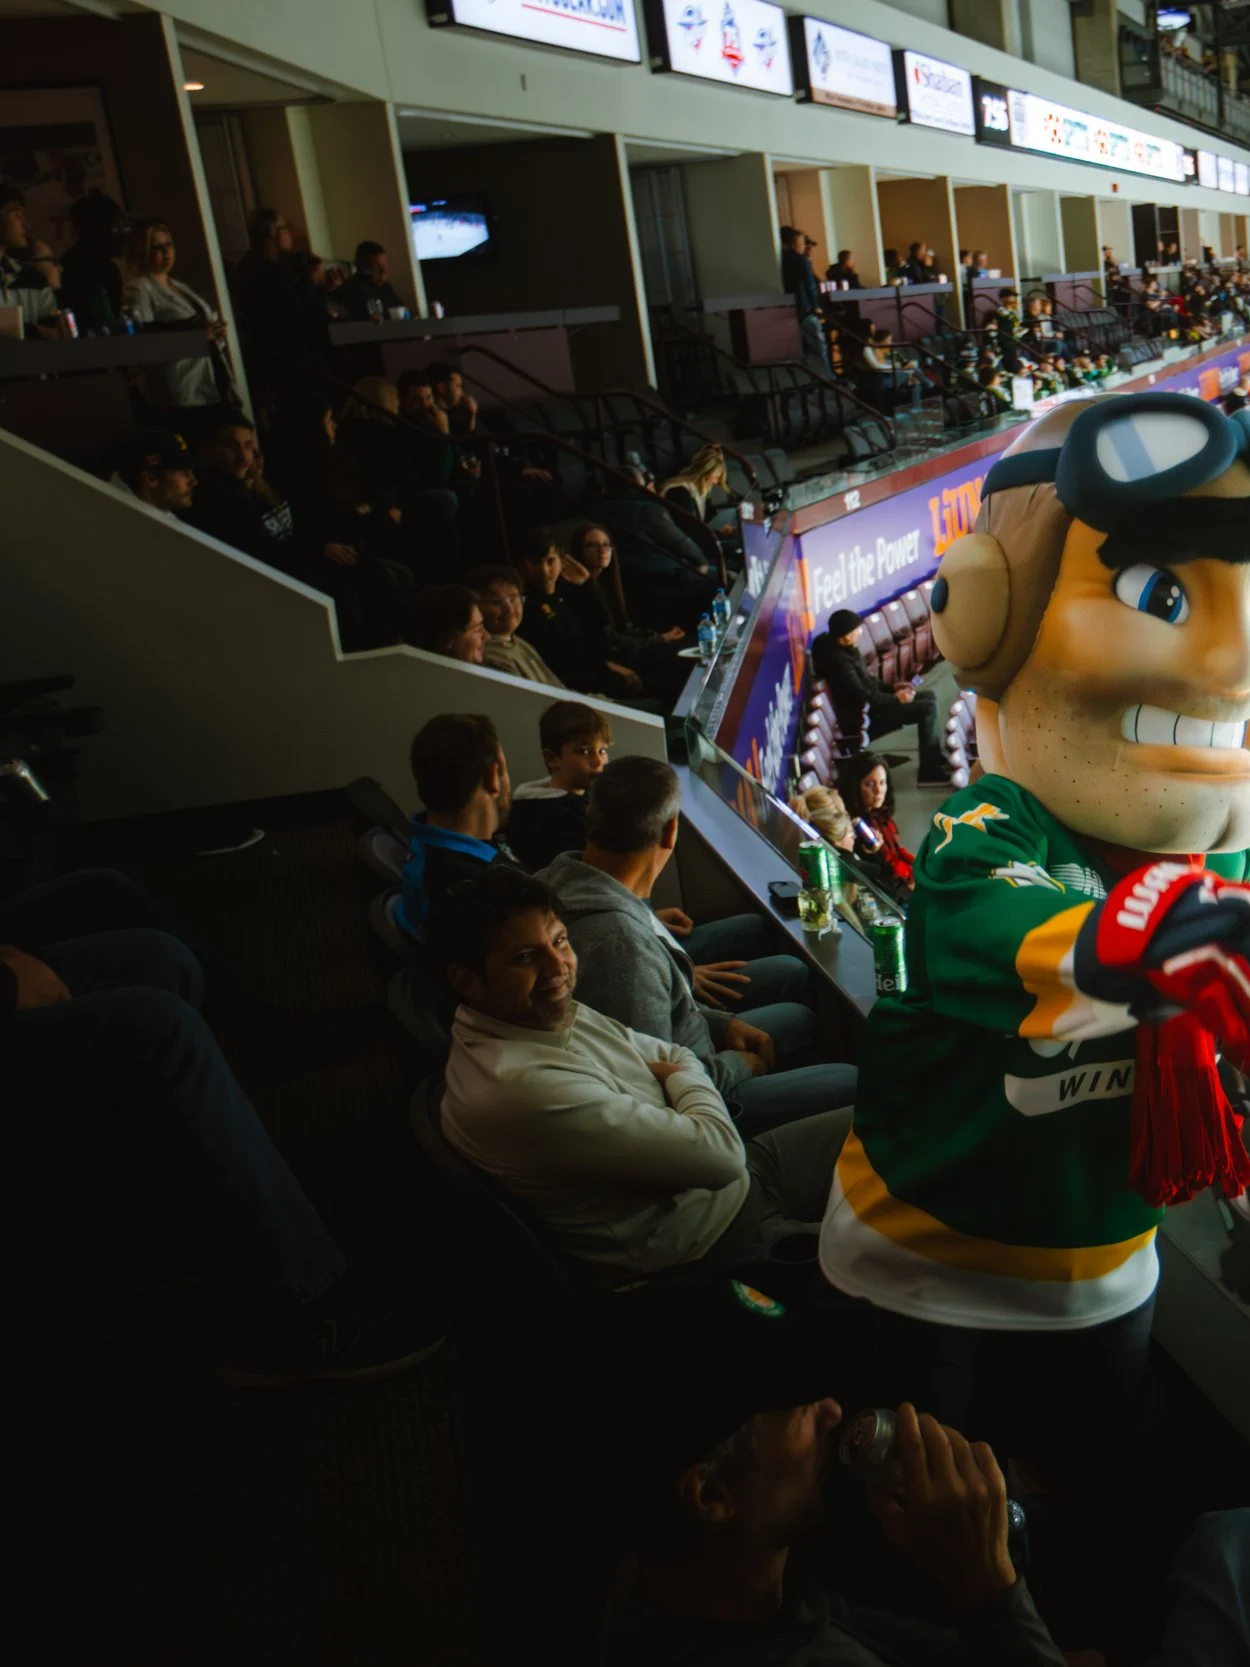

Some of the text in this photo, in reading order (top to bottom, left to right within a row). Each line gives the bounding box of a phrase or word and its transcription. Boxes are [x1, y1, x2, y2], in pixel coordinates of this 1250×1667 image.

[812, 551, 848, 615] Feel
[849, 545, 876, 594] the
[876, 529, 920, 580] Power
